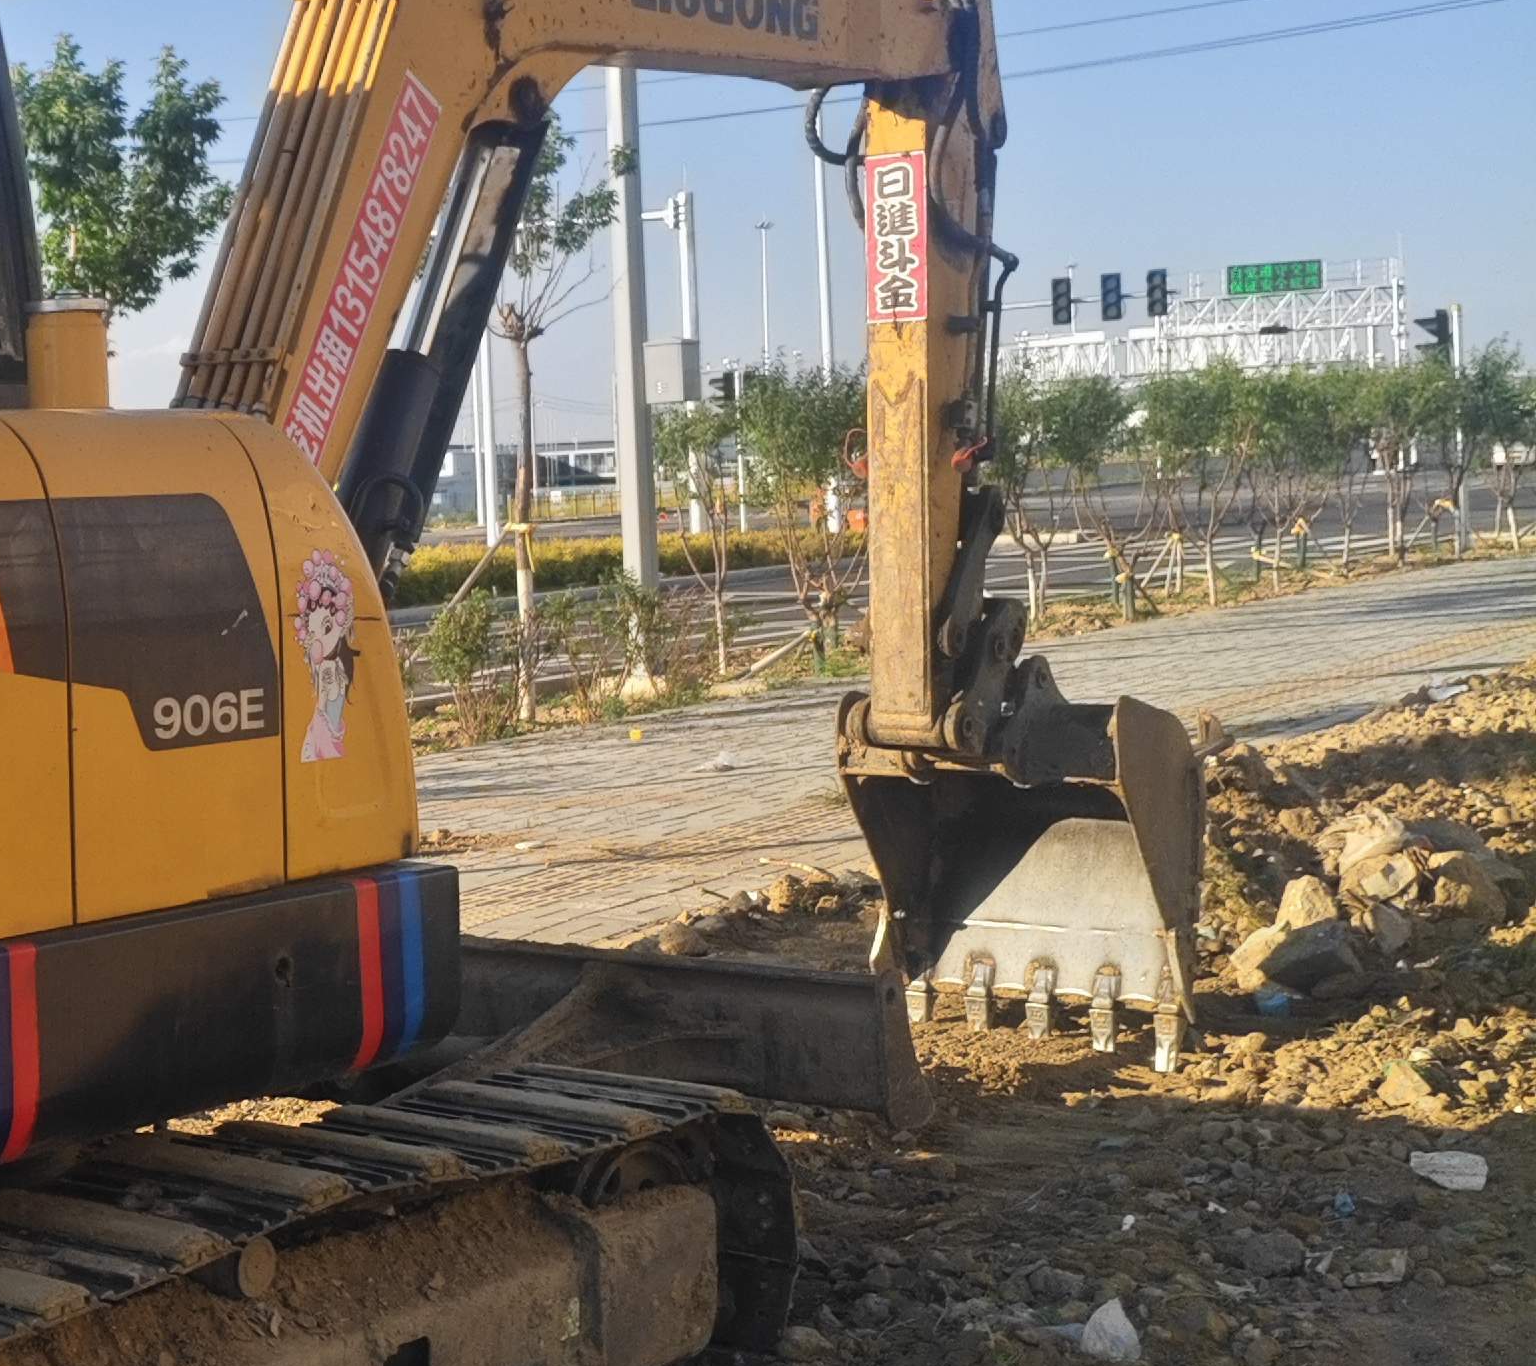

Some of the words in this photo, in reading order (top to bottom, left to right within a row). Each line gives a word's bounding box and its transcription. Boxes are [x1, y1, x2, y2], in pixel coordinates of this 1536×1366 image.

[876, 165, 916, 310] 日進斗金
[153, 688, 264, 740] 906E
